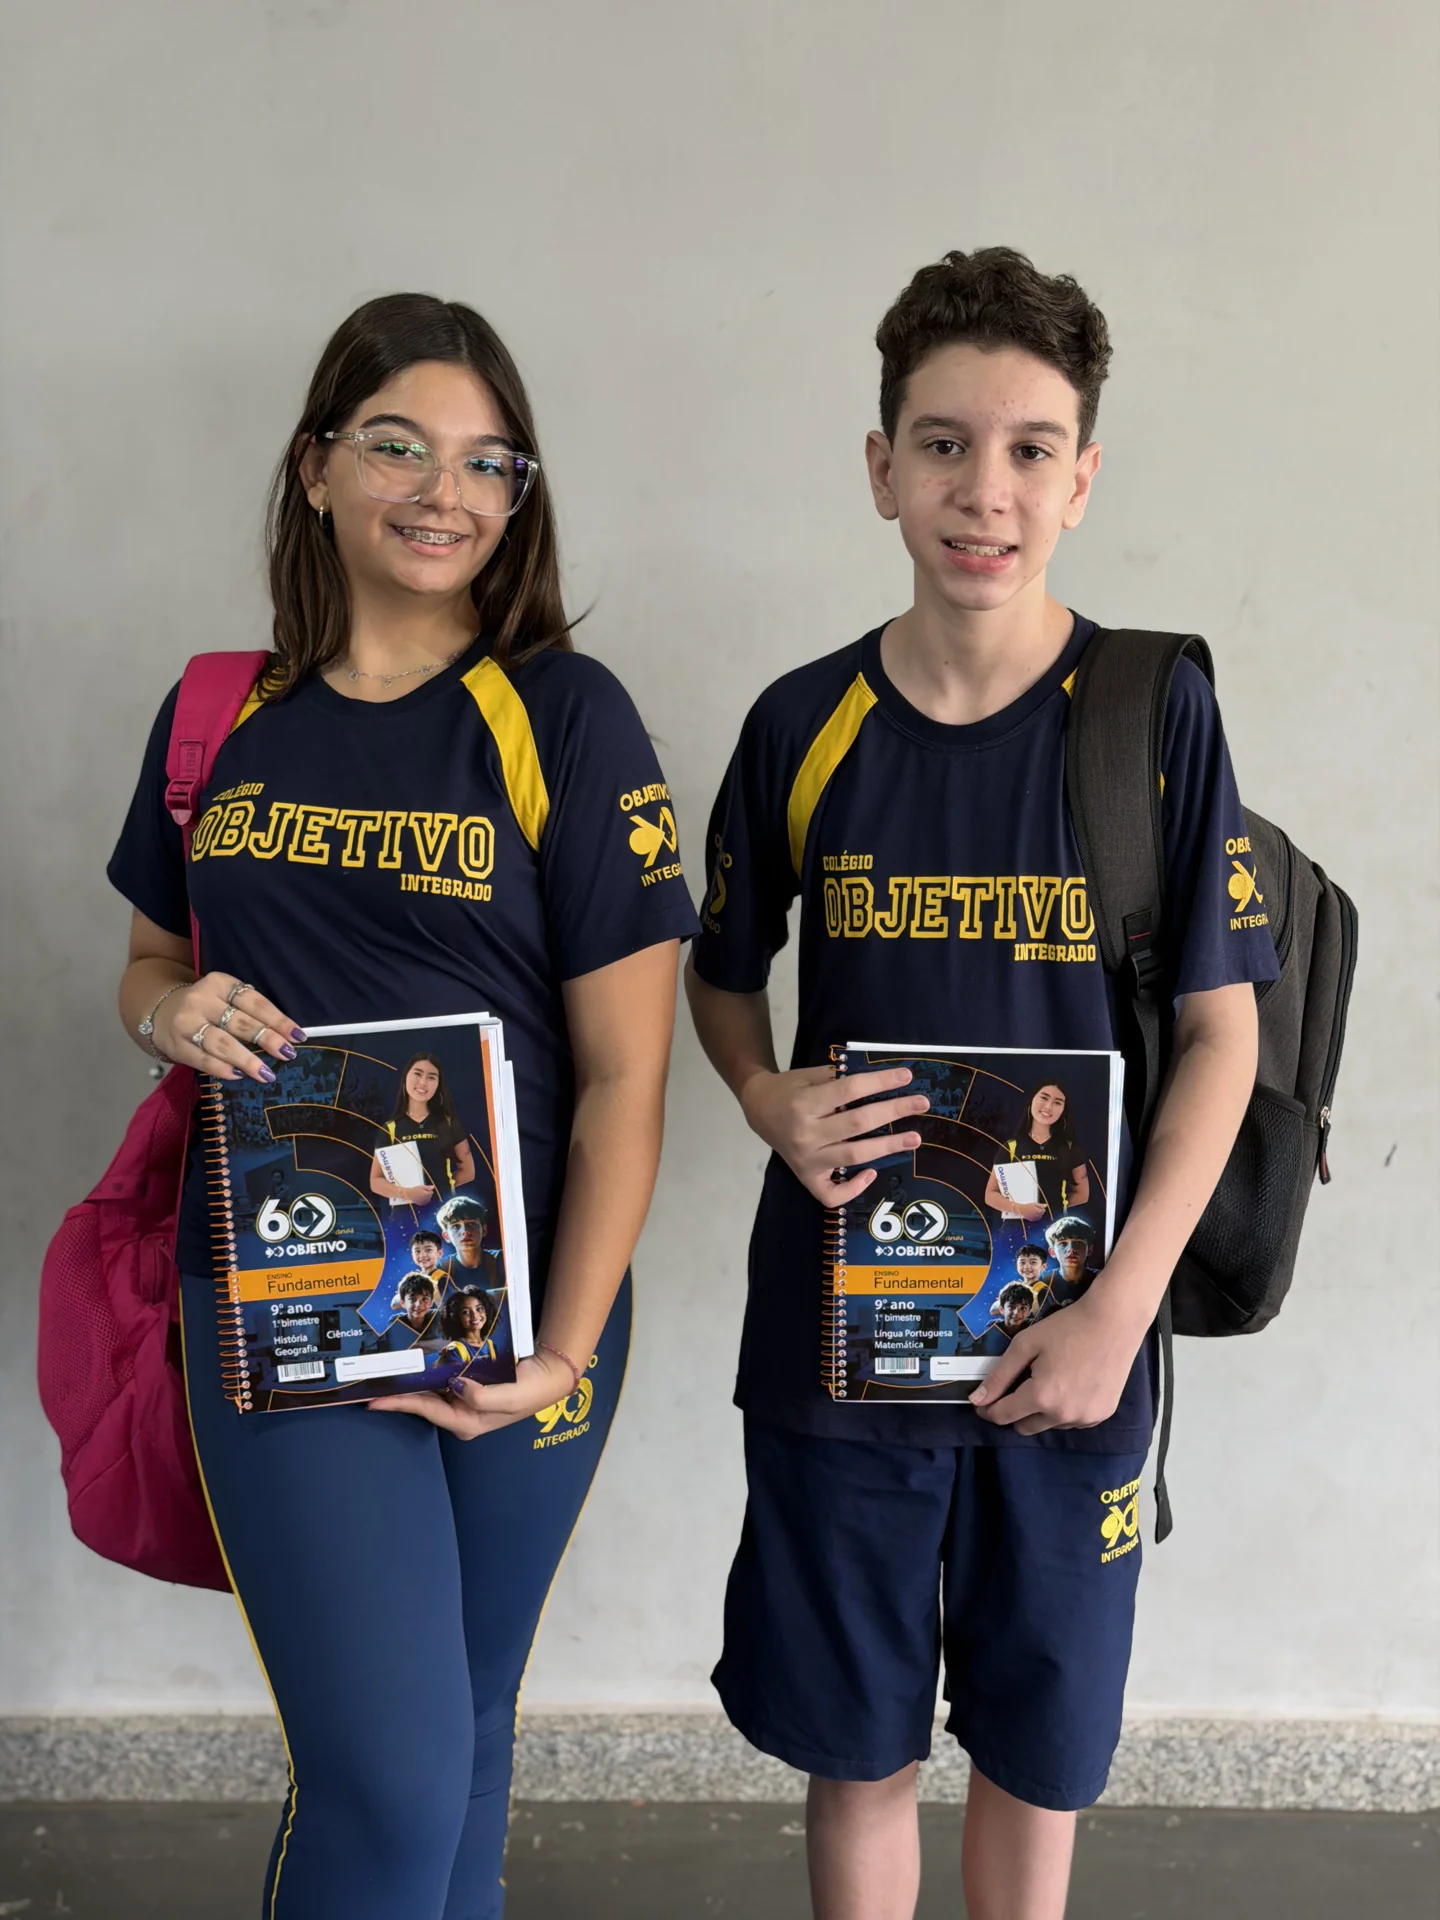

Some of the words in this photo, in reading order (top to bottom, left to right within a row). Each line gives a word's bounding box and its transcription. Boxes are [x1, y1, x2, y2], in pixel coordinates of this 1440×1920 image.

[191, 800, 496, 881] OBJETIVO
[822, 849, 874, 871] COLÉGIO
[400, 873, 493, 903] INTEGRADO
[823, 875, 1095, 940] OBJETIVO
[1013, 943, 1097, 964] INTEGRADO
[286, 1240, 347, 1256] OBJETIVO
[895, 1245, 955, 1257] OBJETIVO
[266, 1272, 293, 1281] ENSINO
[267, 1273, 360, 1293] Fundamental
[873, 1277, 964, 1289] Fundamental
[287, 1304, 313, 1315] ano
[890, 1300, 915, 1311] ano
[281, 1316, 320, 1328] bimestre
[884, 1313, 921, 1322] bimestre
[273, 1334, 309, 1345] História
[326, 1328, 364, 1340] Ciências
[874, 1330, 903, 1339] Língua
[904, 1329, 953, 1339] Portuguesa
[874, 1341, 924, 1349] Matemática
[275, 1345, 319, 1358] Geografia
[533, 1421, 590, 1450] INTEGRADO
